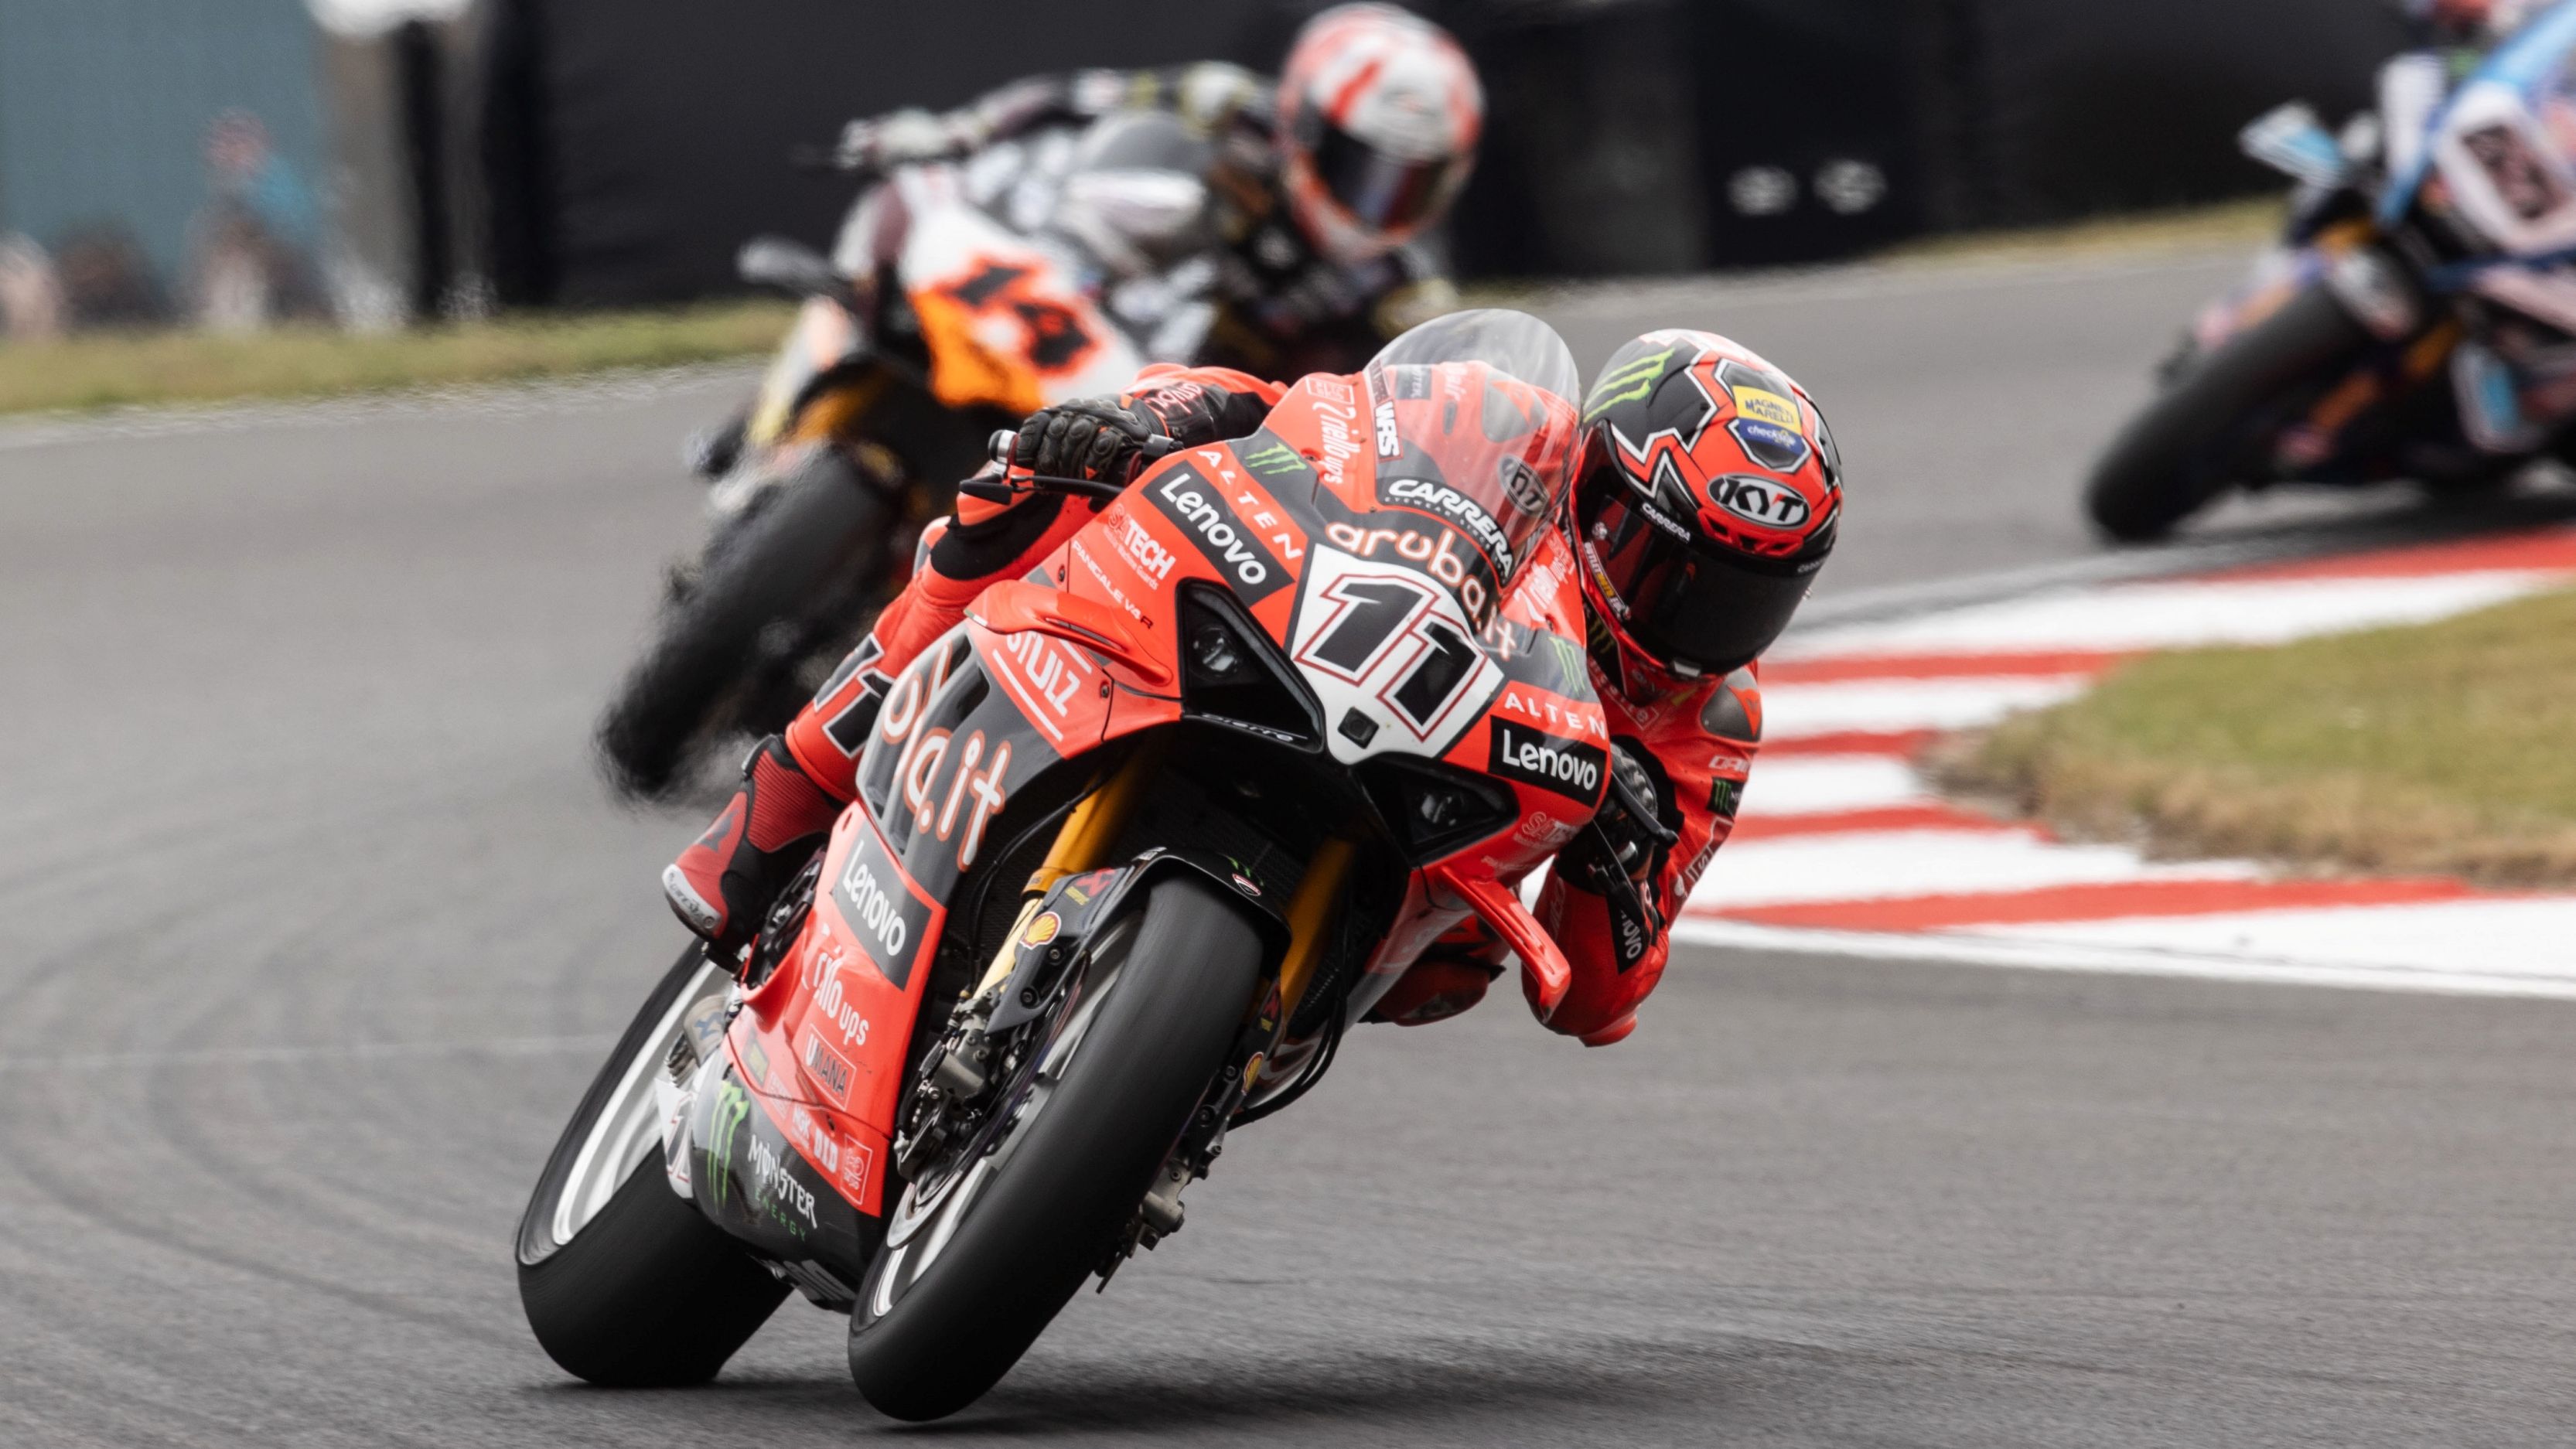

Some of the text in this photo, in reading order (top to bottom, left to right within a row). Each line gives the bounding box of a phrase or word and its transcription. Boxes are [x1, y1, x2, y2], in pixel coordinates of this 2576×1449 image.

[1375, 401, 1401, 456] WRS
[1159, 472, 1267, 585] Lenovo
[1196, 450, 1304, 561] ALTEN
[1388, 479, 1513, 580] CARRERA
[1642, 502, 1691, 543] CARRERA
[1718, 476, 1804, 523] KYT
[1326, 521, 1517, 662] aruba.it
[1296, 573, 1488, 741] 11
[1501, 729, 1598, 791] Lenovo
[1503, 691, 1607, 740] ALTEN
[842, 839, 907, 956] Lenovo
[838, 1001, 869, 1046] ups
[748, 1133, 817, 1229] MONSTER
